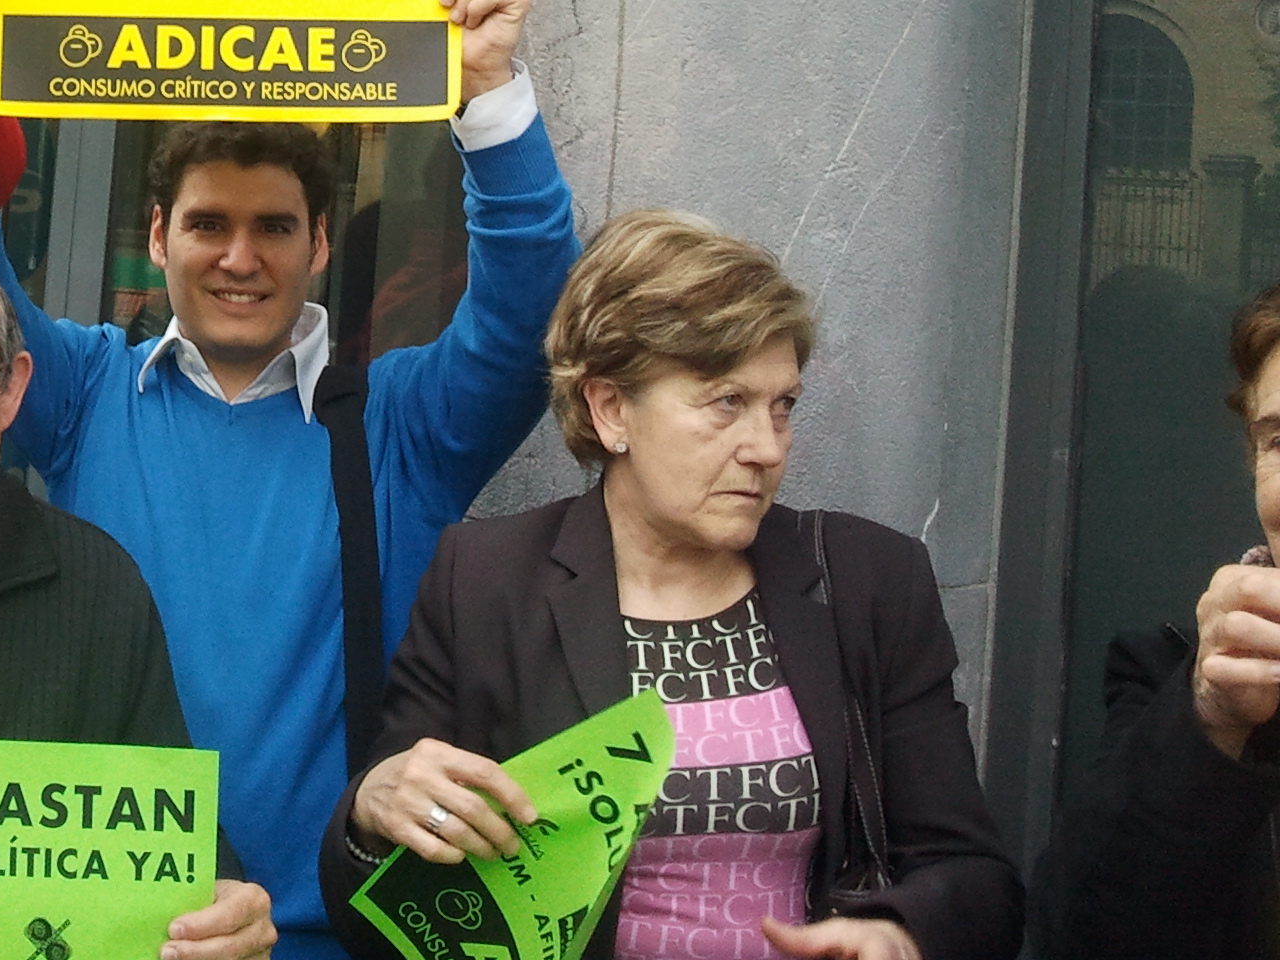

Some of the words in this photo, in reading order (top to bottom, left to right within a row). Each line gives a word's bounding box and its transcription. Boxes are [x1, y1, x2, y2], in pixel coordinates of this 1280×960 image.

[106, 24, 335, 72] ADICAE
[49, 77, 156, 98] CONSUMO
[161, 75, 238, 100] CRÍTICO
[242, 81, 255, 100] Y
[261, 81, 397, 101] RESPONSABLE
[627, 624, 775, 671] TFCTF
[630, 653, 779, 702] FCTFC
[605, 730, 653, 764] 7
[126, 850, 195, 884] YA!
